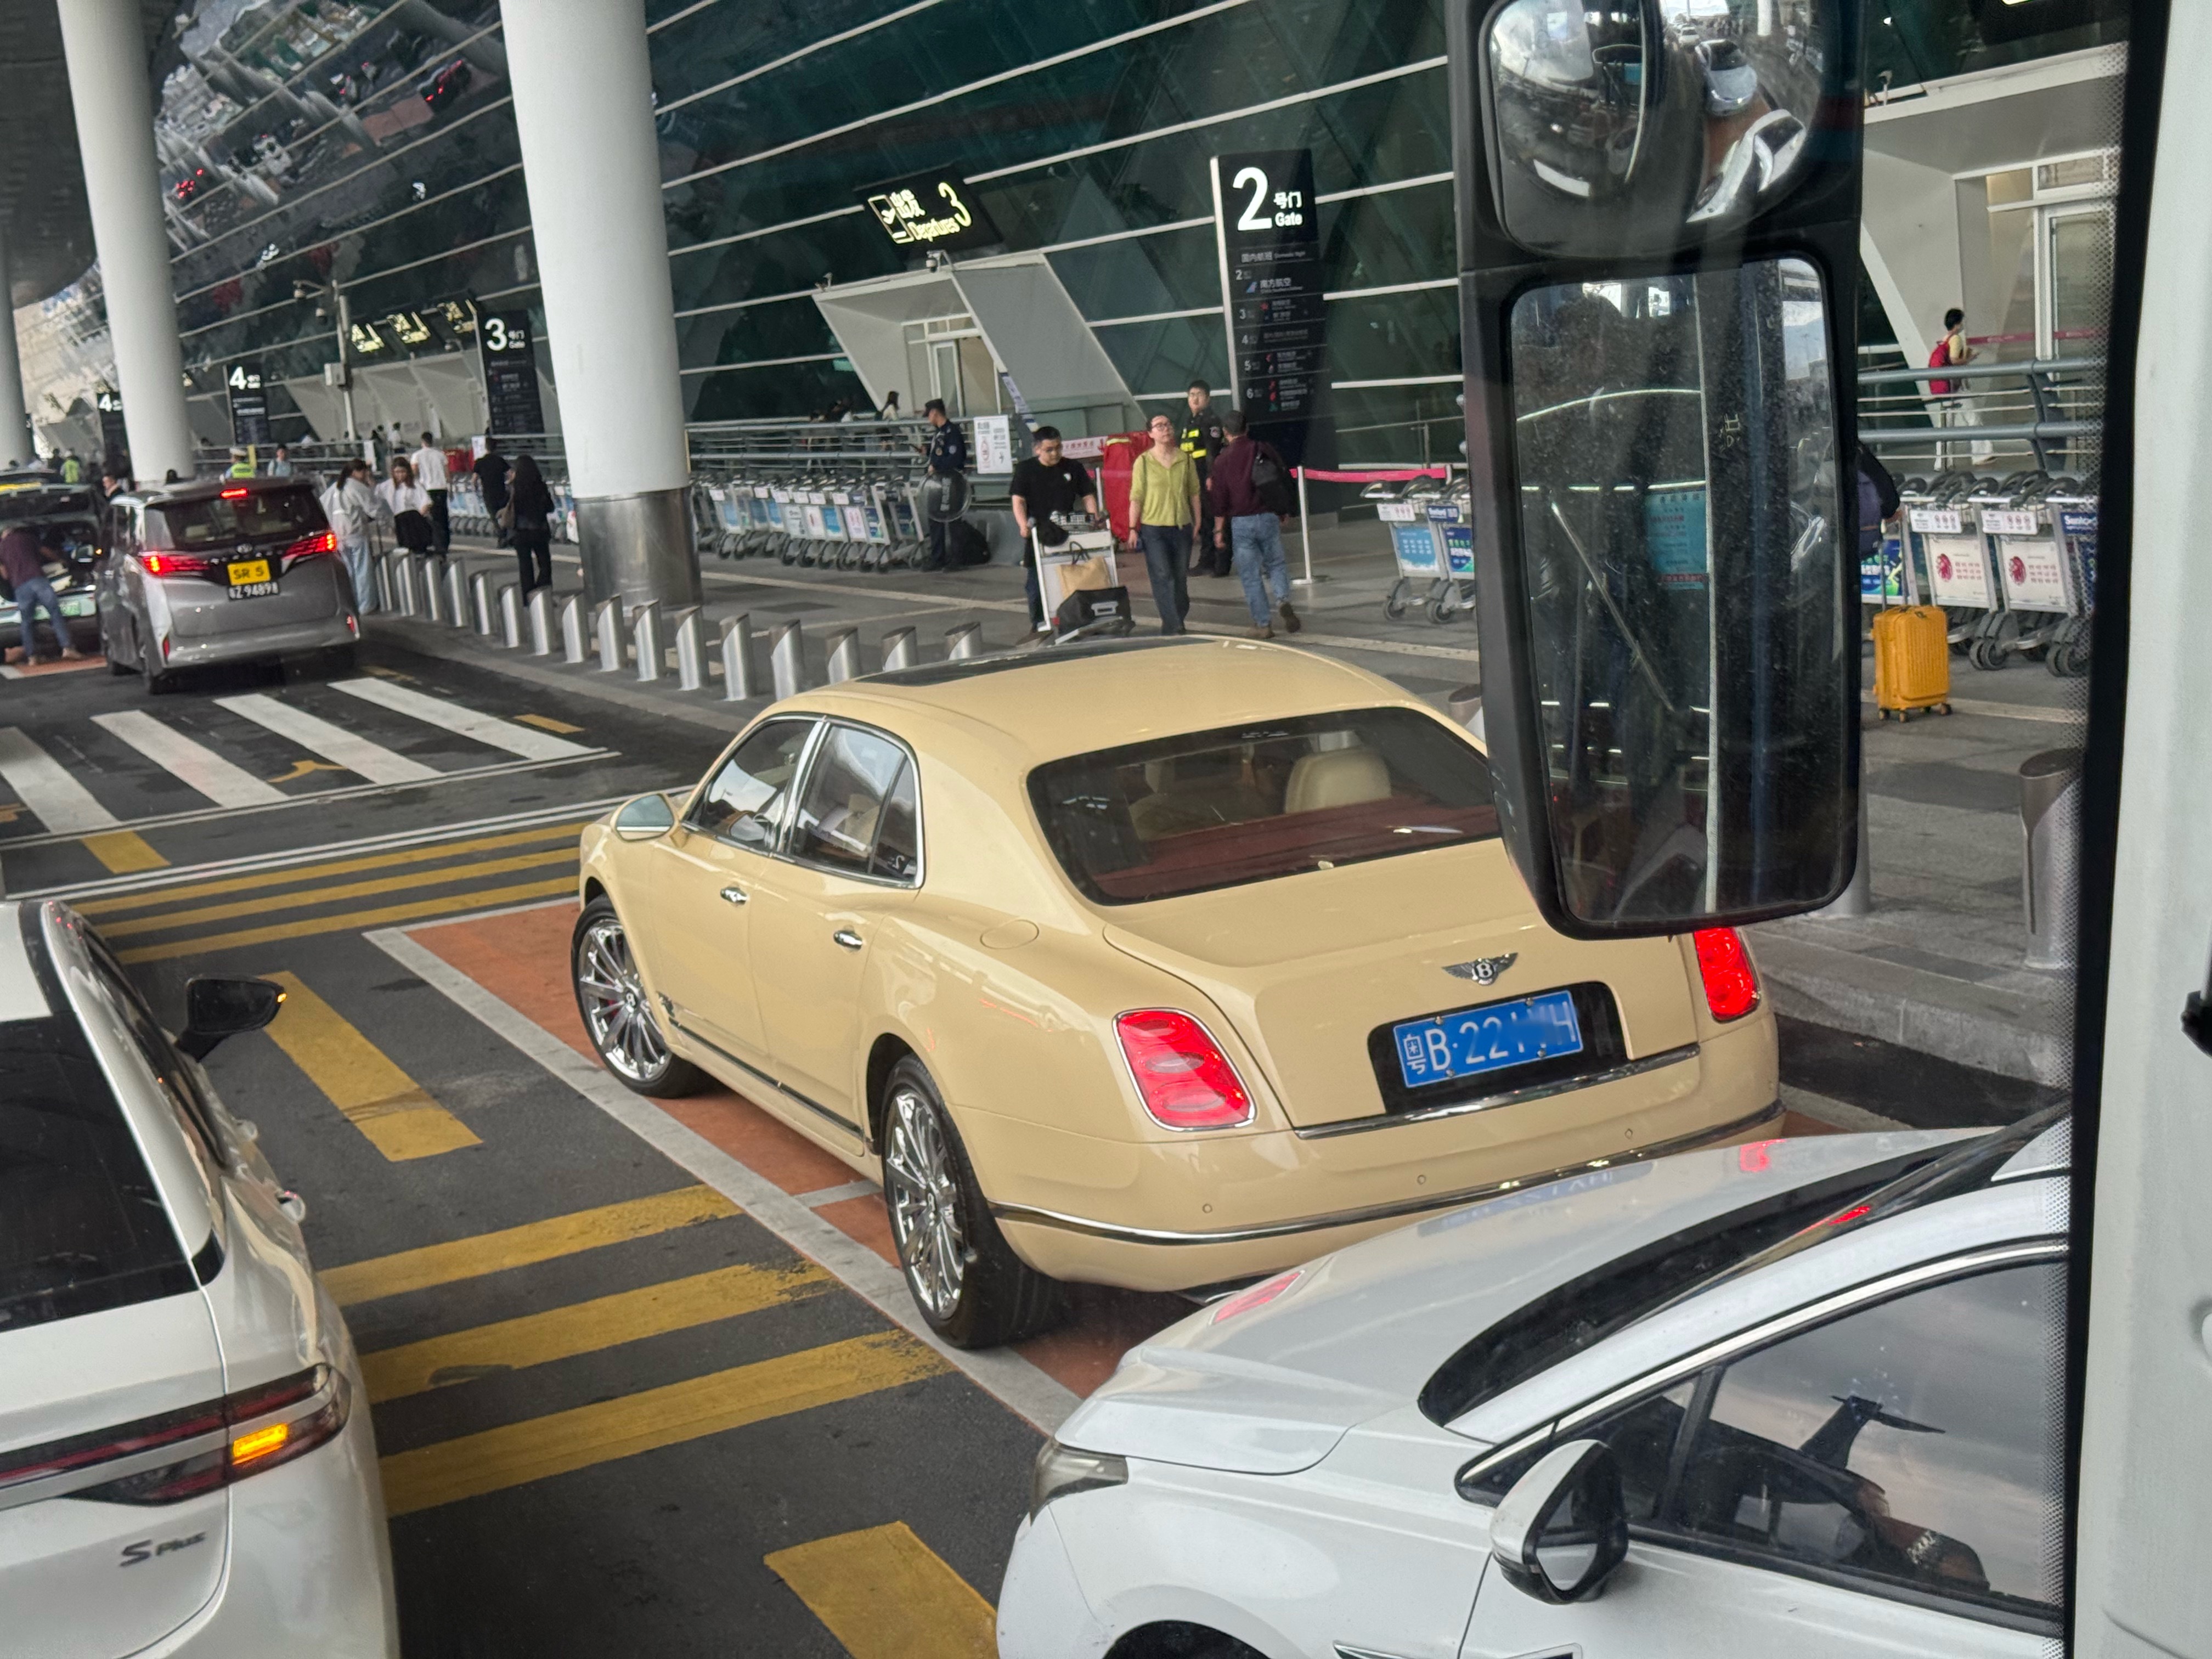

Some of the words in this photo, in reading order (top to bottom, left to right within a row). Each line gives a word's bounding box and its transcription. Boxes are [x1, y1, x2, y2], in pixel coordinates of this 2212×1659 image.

[938, 182, 972, 227] 3
[1233, 167, 1272, 230] 2
[1273, 191, 1302, 209] 号门
[1275, 212, 1303, 227] Gate
[485, 318, 507, 352] 3
[229, 366, 247, 390] 4
[99, 393, 112, 412] 4
